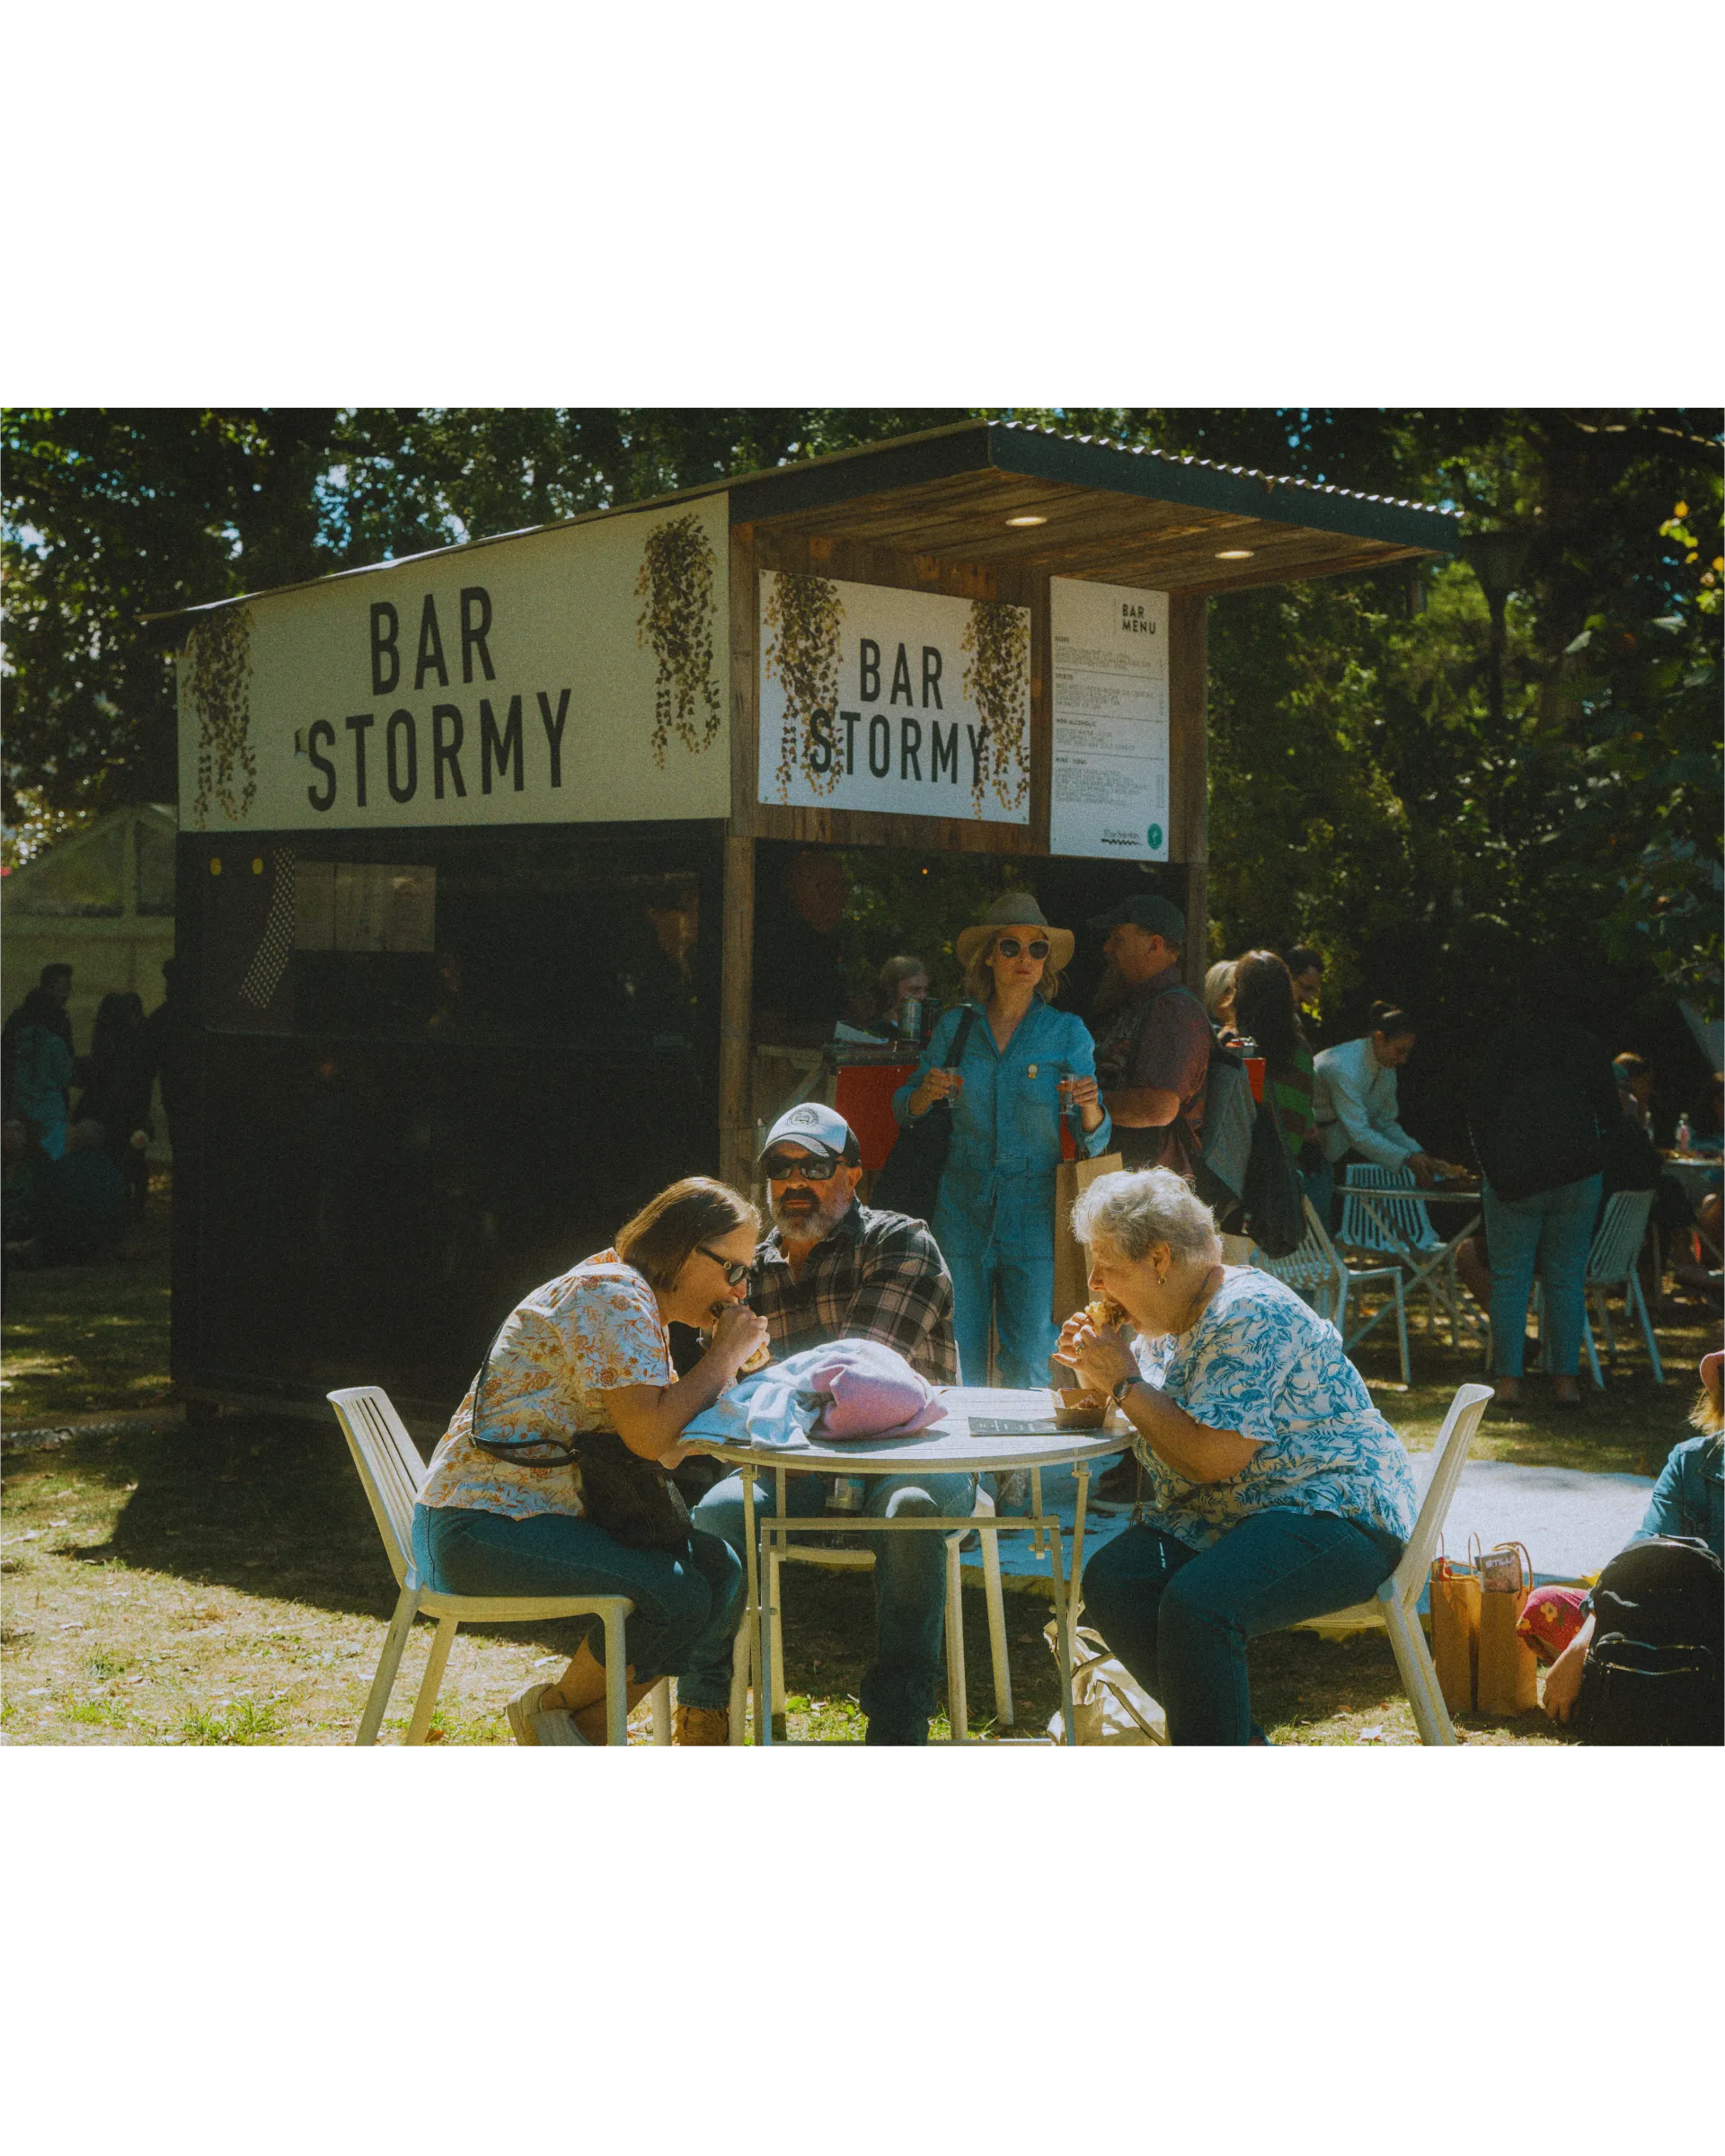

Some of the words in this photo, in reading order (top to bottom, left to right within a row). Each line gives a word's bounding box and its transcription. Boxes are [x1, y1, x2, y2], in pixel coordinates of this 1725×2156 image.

[370, 586, 496, 696] BAR
[1121, 619, 1156, 635] MENU
[1122, 604, 1145, 618] BAR
[860, 638, 942, 710] BAR
[308, 688, 571, 811] STORMY
[809, 708, 987, 787] STORMY
